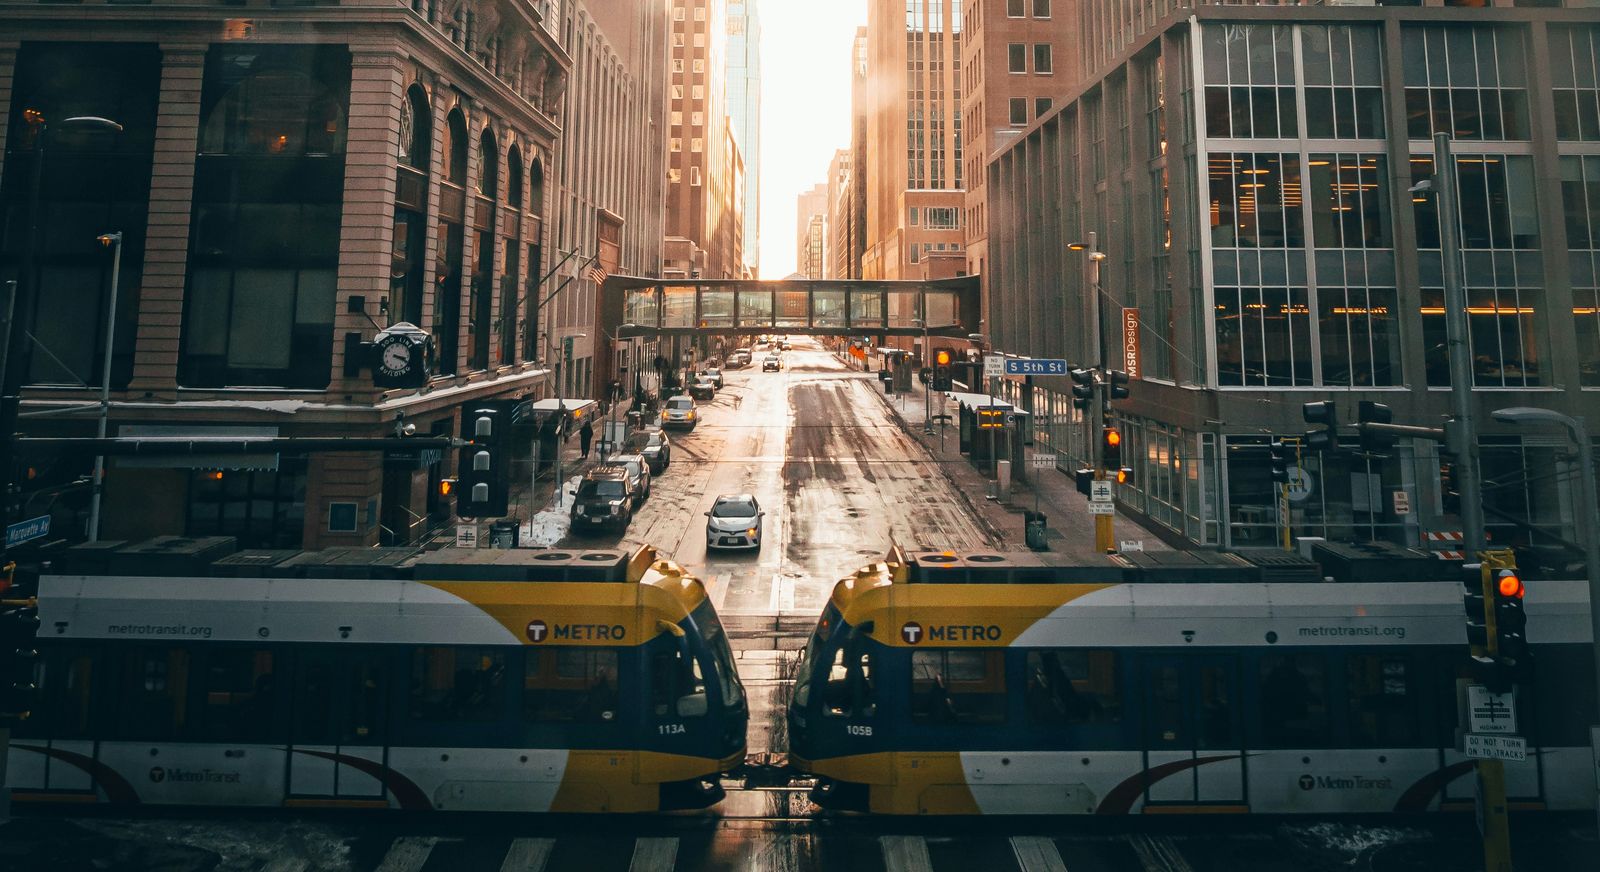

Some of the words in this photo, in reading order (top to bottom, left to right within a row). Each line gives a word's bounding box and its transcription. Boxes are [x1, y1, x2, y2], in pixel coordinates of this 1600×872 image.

[381, 337, 395, 348] SOO
[1126, 313, 1138, 377] MSRDesign
[379, 365, 411, 377] BUILDING
[1010, 362, 1018, 372] S
[1023, 362, 1044, 372] 5th
[1049, 362, 1062, 372] St
[9, 523, 39, 541] Marquette
[108, 624, 212, 638] metrotransit.org
[553, 623, 625, 640] METRO
[929, 625, 1002, 641] METRO
[1299, 625, 1406, 639] metrotransit.org
[658, 723, 687, 735] 113A
[846, 725, 873, 736] 105B
[1484, 738, 1496, 746] NOT
[1503, 739, 1521, 748] TURN
[1483, 748, 1491, 756] TO
[1497, 750, 1524, 759] TRACKS
